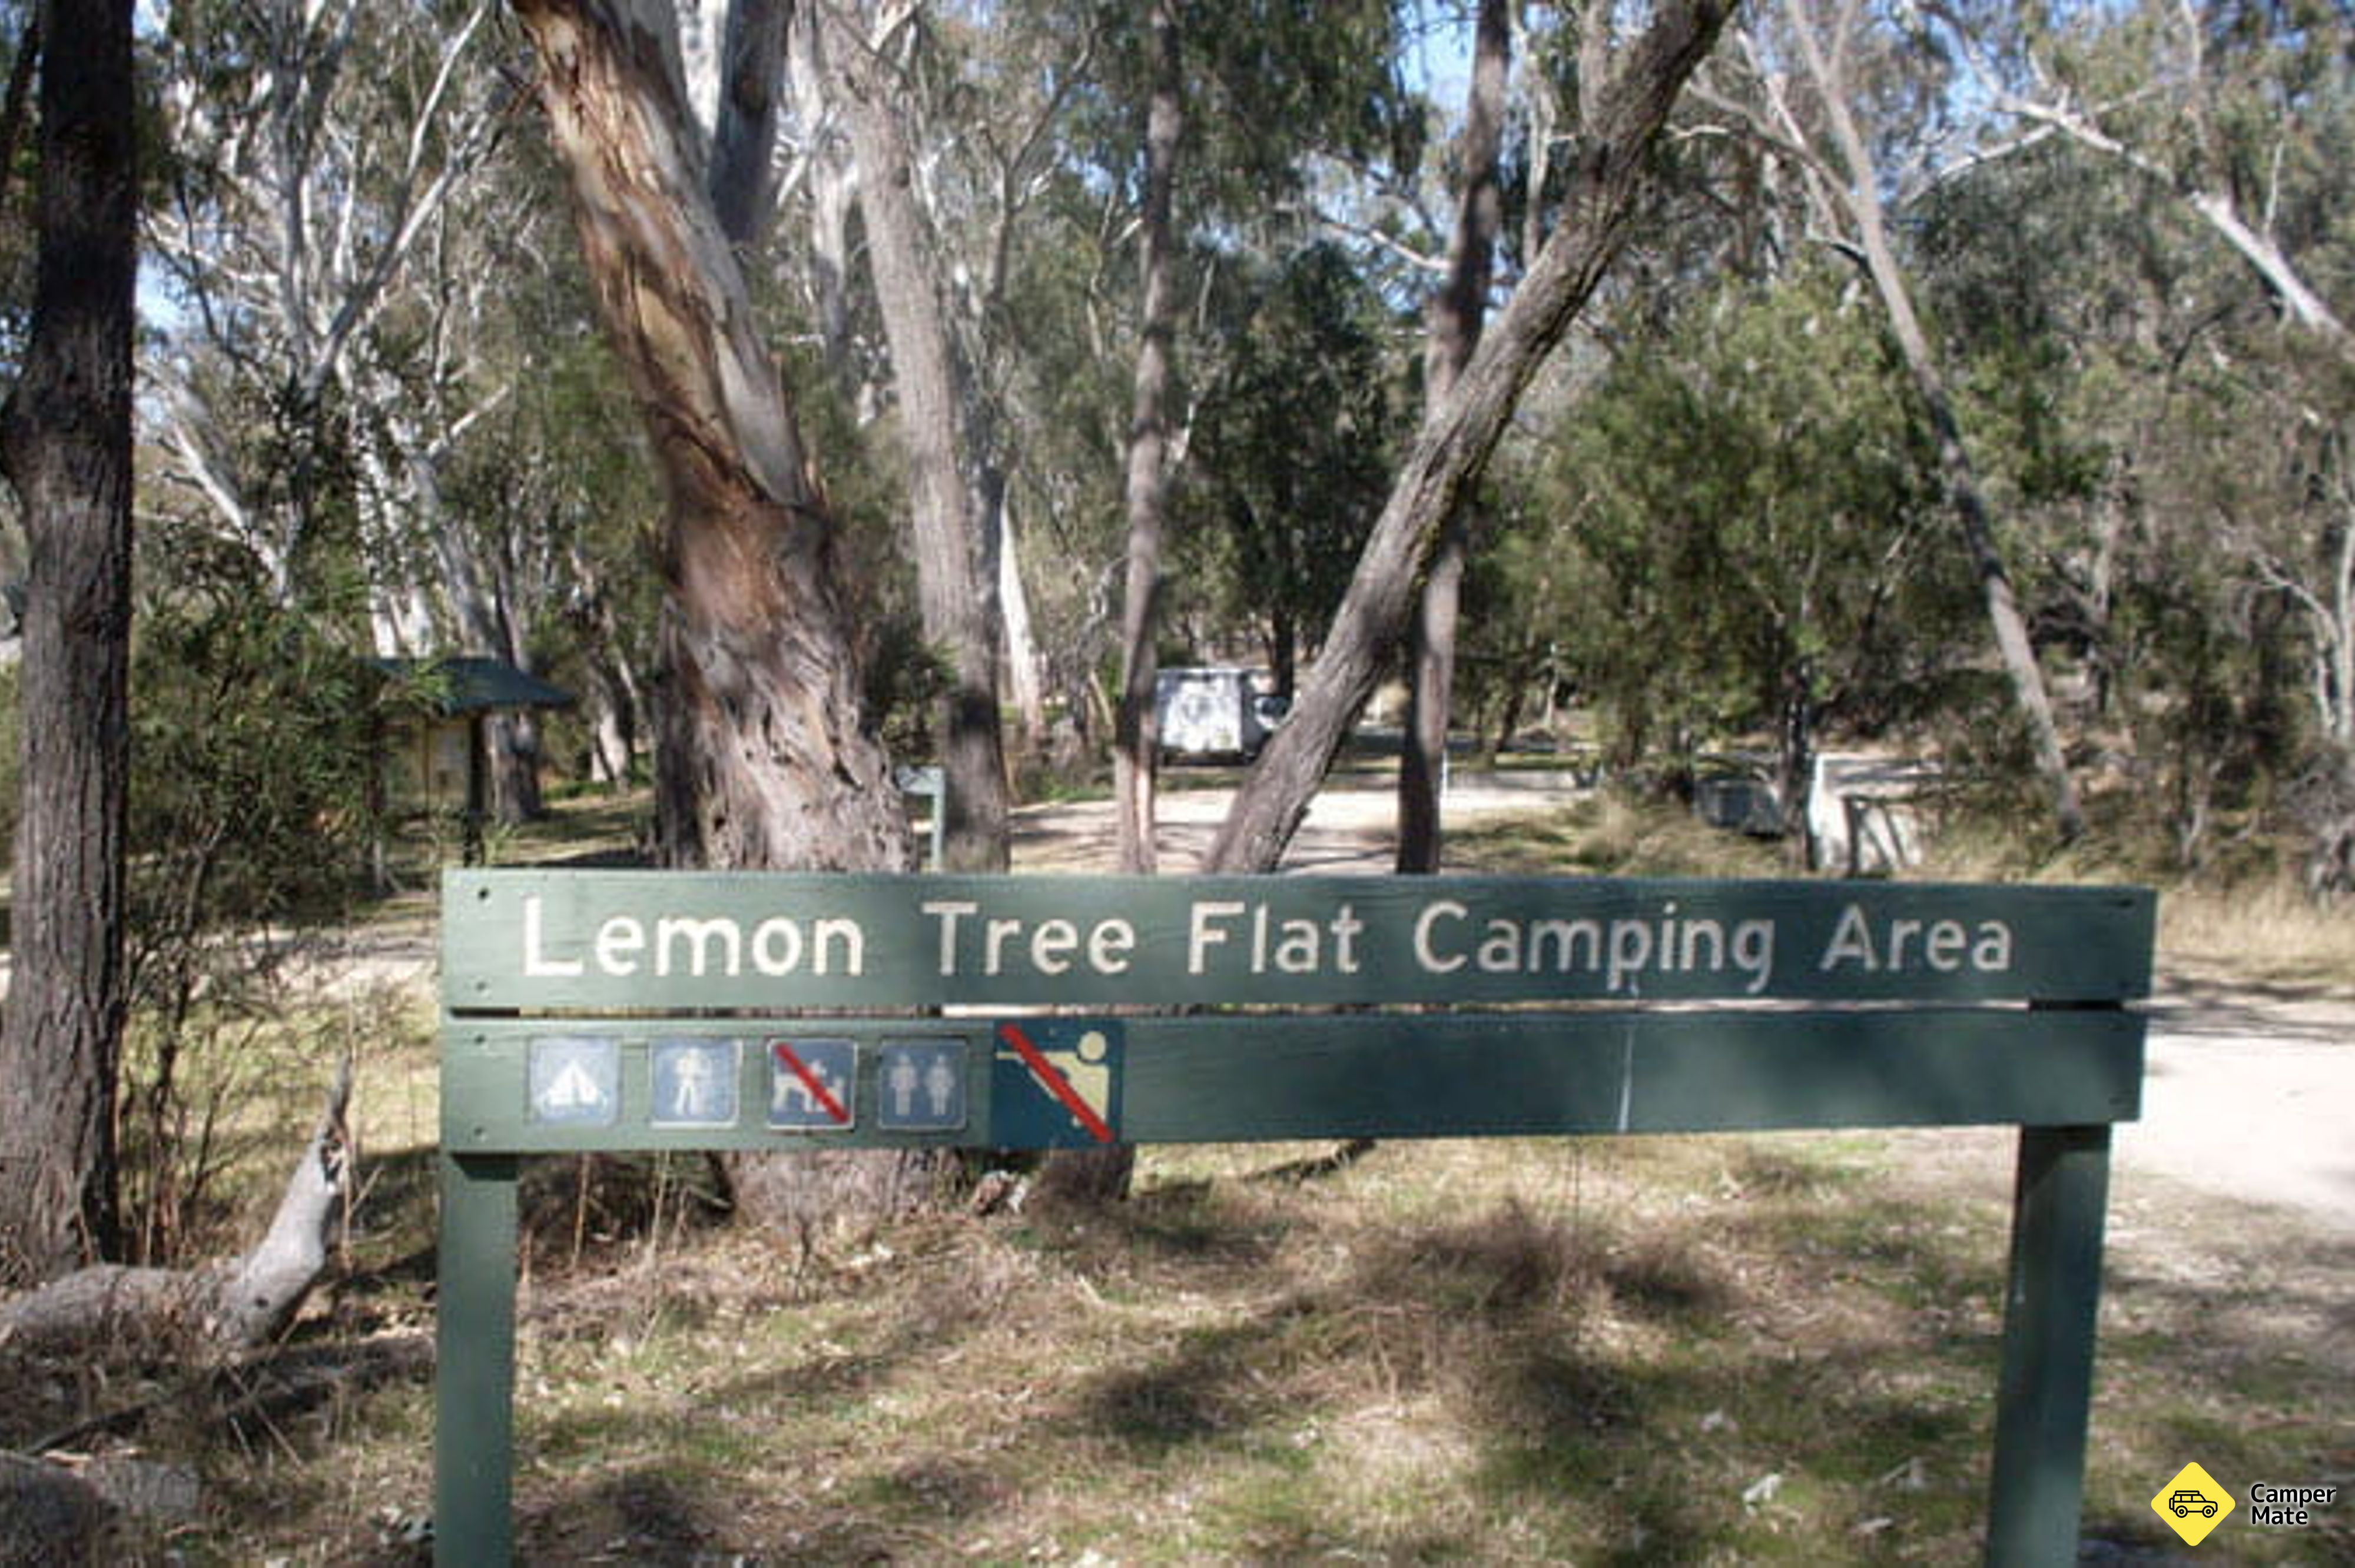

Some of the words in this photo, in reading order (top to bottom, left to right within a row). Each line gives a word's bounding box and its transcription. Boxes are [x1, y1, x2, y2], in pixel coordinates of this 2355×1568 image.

[522, 898, 865, 978] Lemon
[921, 902, 1135, 975] Tree
[1188, 902, 1362, 974] Flat
[1413, 901, 1775, 994] Camping
[1819, 904, 2012, 972] Area
